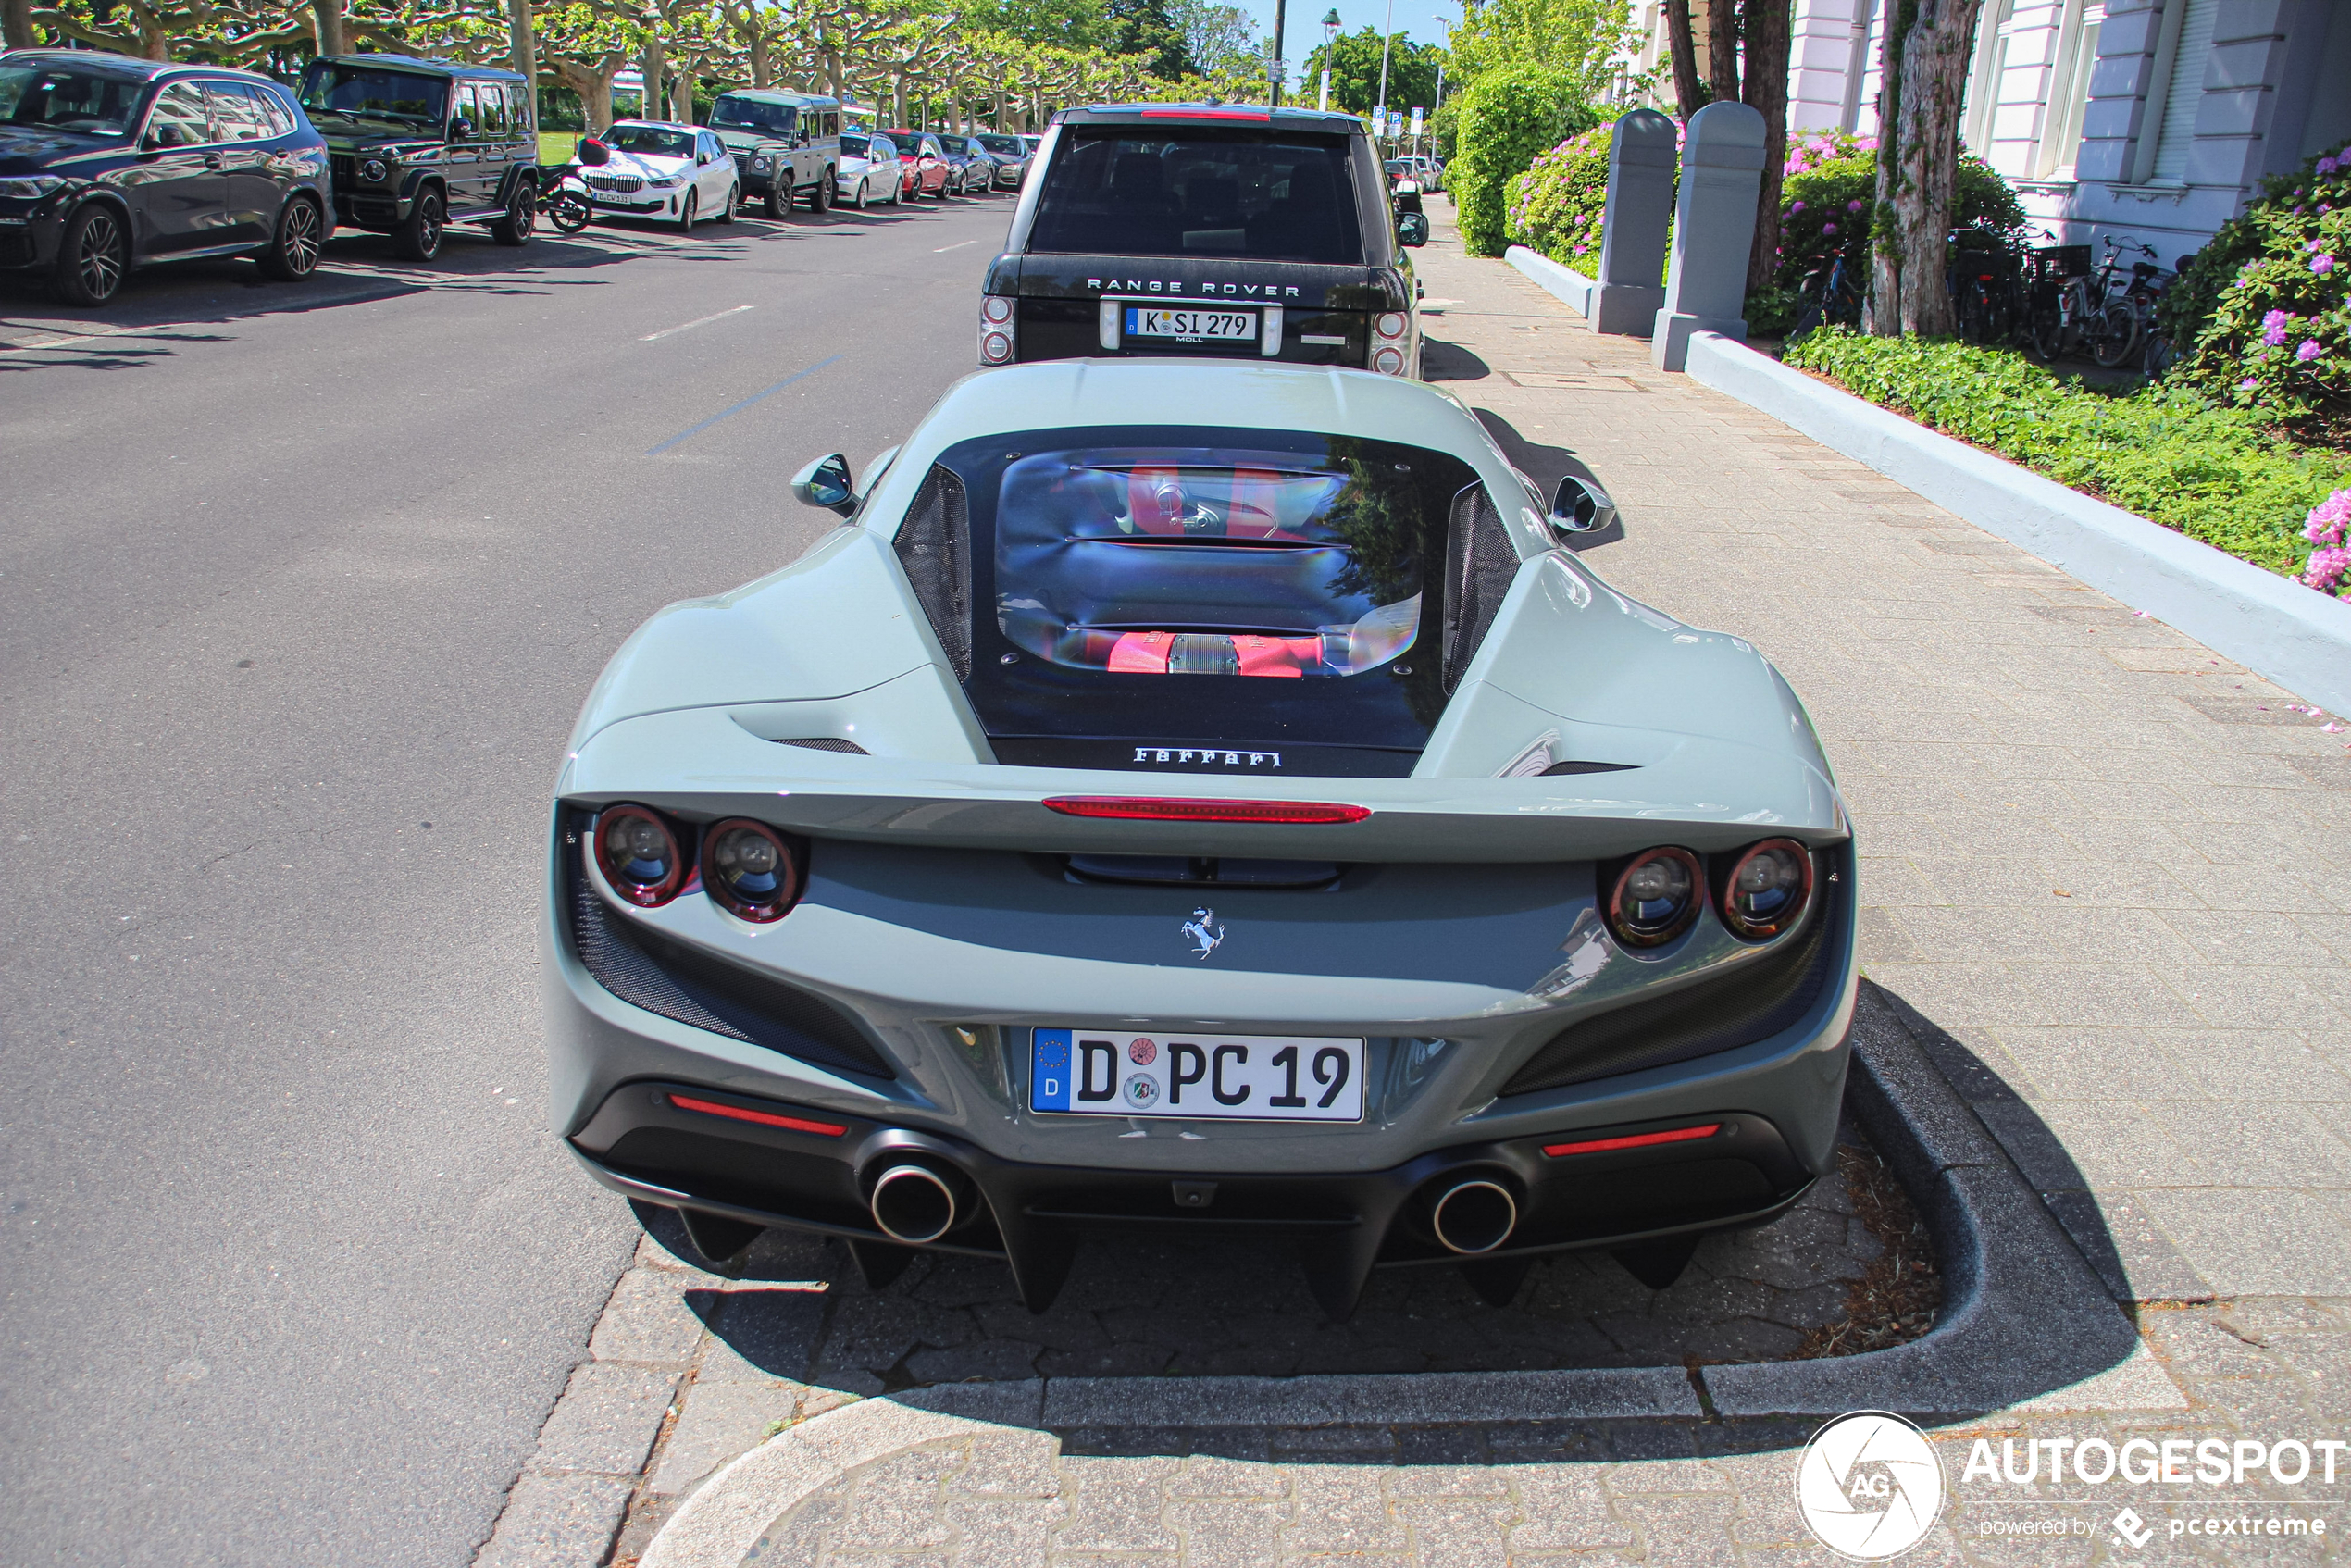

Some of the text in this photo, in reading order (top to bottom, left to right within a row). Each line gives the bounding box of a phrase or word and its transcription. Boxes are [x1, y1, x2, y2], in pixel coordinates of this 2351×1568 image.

[1088, 278, 1300, 297] RANGE ROVER
[1146, 312, 1247, 336] K SI 279
[1133, 747, 1282, 768] Ferrari
[1077, 1039, 1118, 1101] D
[1166, 1043, 1250, 1106] PC
[1269, 1046, 1350, 1108] 19
[1045, 1078, 1059, 1096] D
